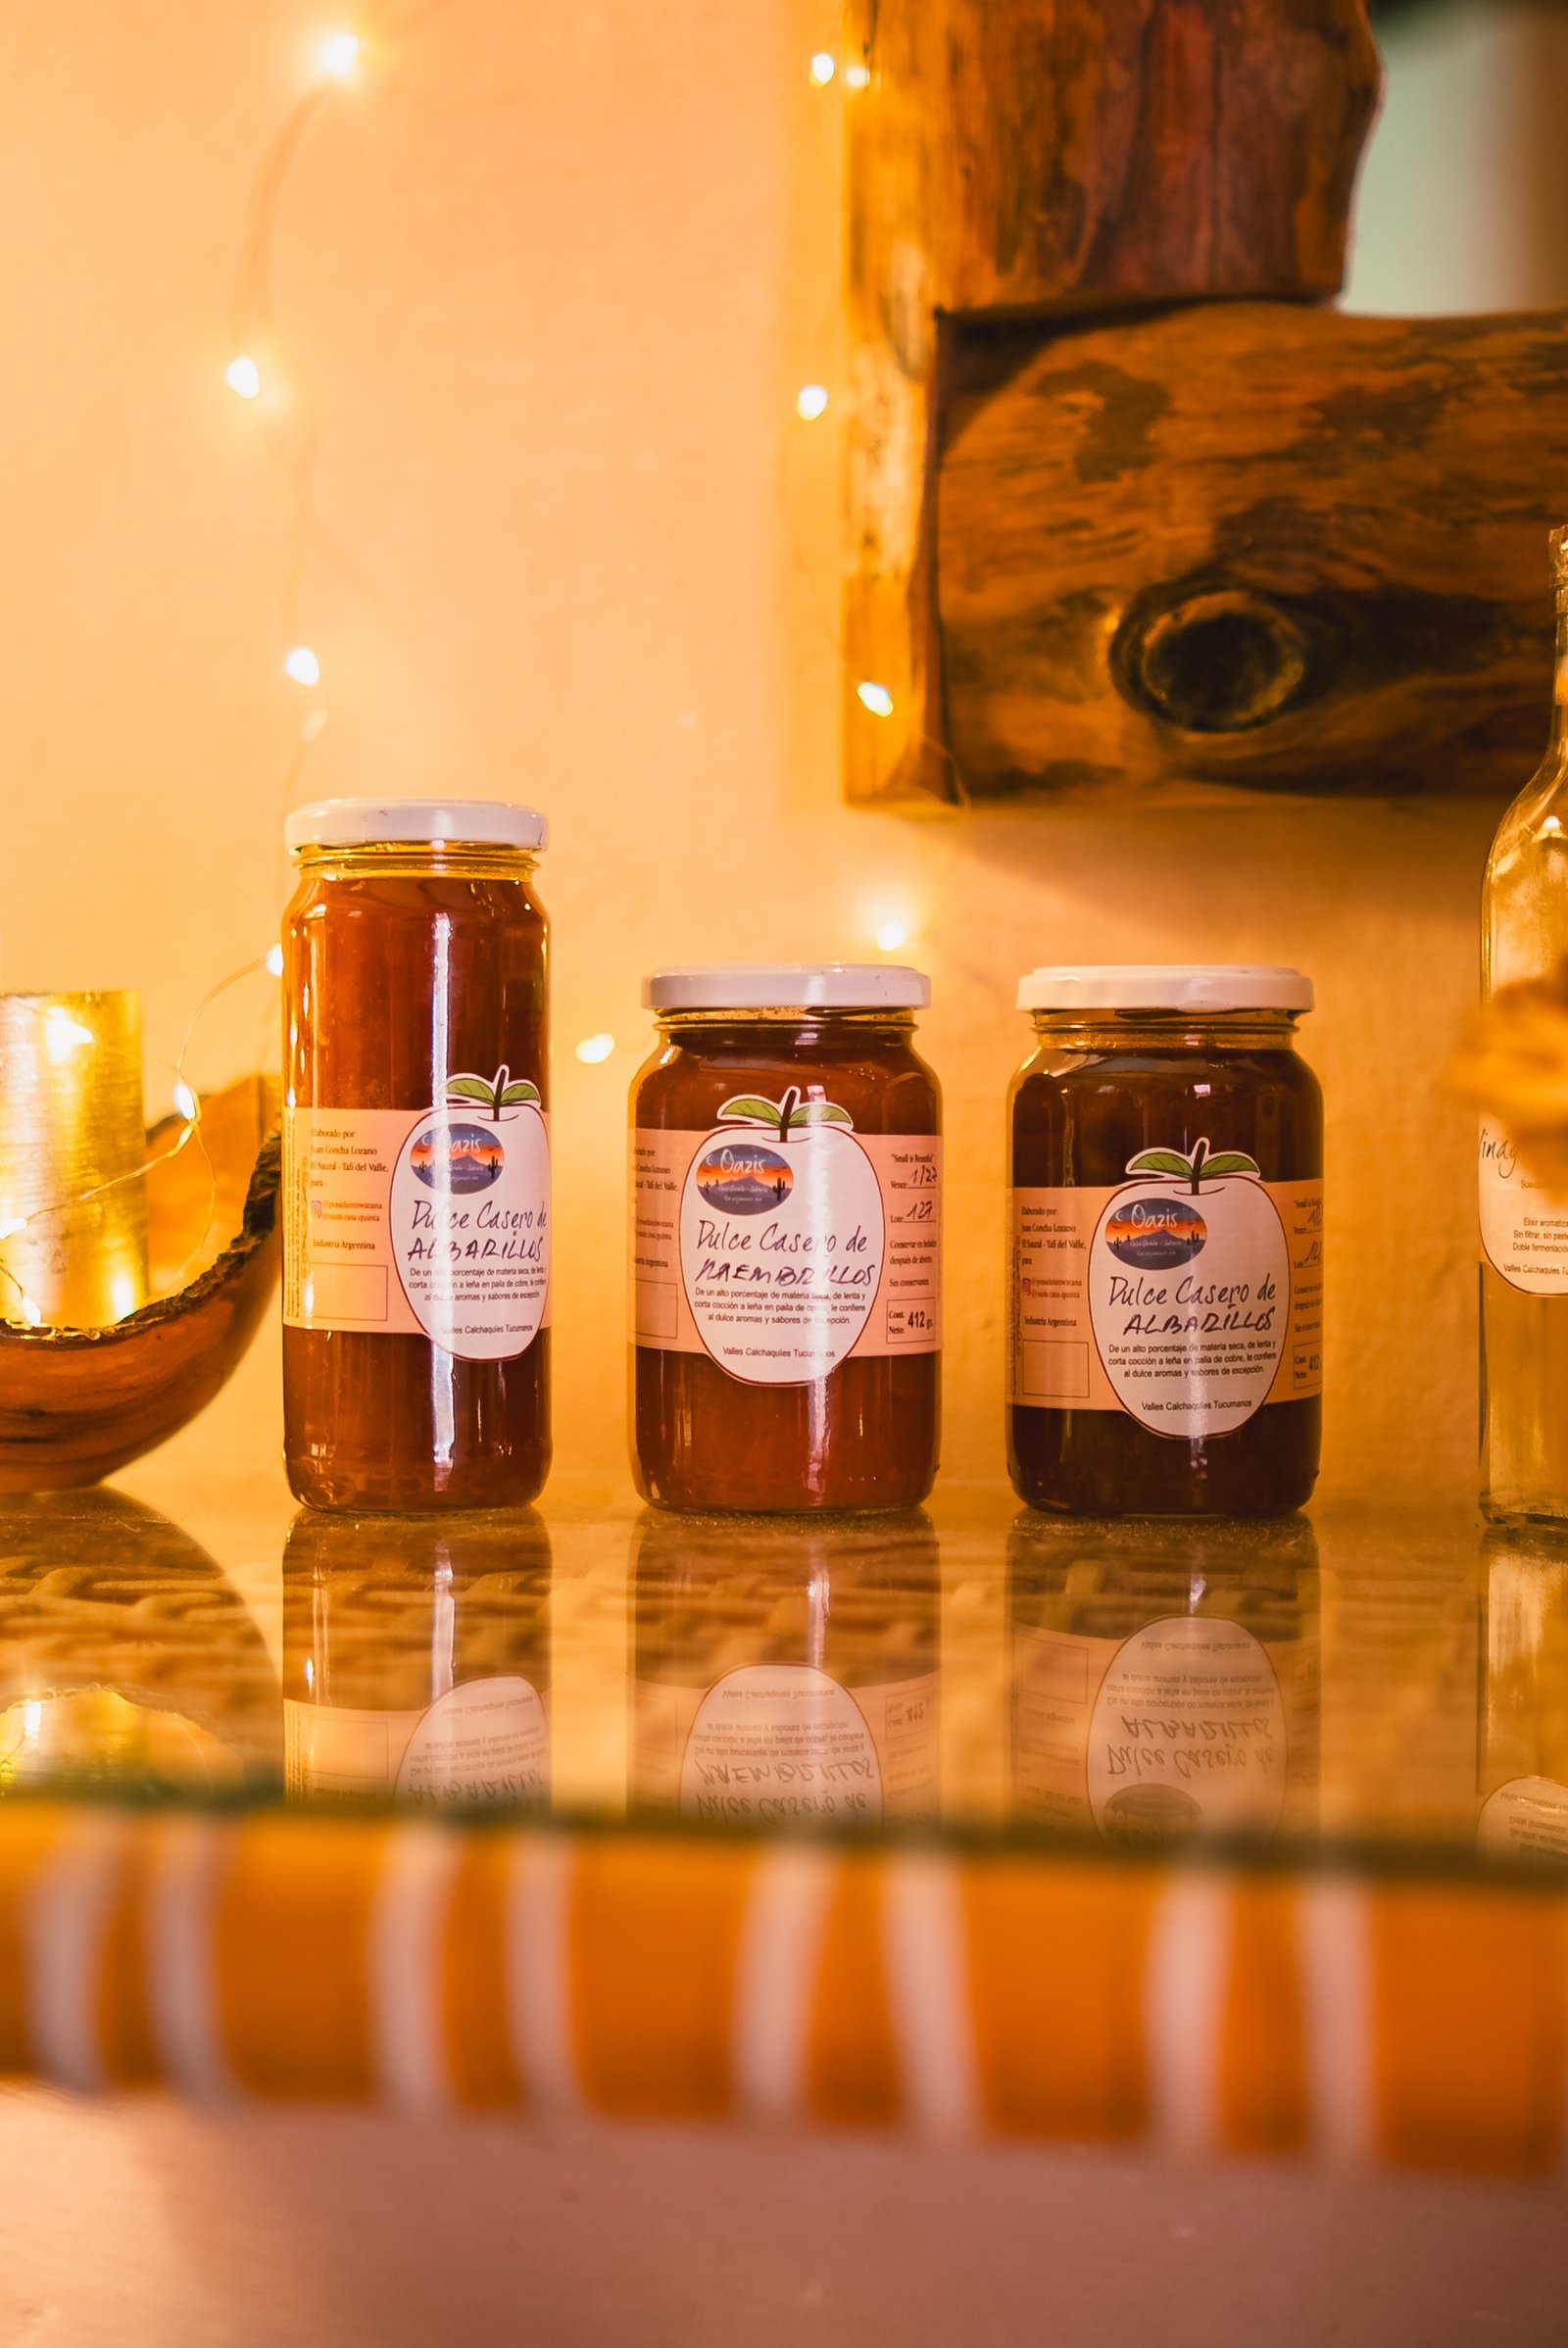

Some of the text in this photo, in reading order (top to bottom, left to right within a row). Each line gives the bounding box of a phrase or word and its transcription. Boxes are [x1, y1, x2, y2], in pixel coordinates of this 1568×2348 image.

[351, 1147, 377, 1155] Lozano
[720, 1149, 765, 1174] Oazis
[355, 1163, 367, 1172] del
[412, 1199, 469, 1230] Duce
[476, 1200, 534, 1230] Casero
[1131, 1203, 1179, 1228] Oazis
[1523, 1217, 1539, 1226] Elixir
[1054, 1223, 1076, 1232] Lozano
[697, 1220, 752, 1249] Dulce
[845, 1225, 867, 1253] de
[1514, 1229, 1523, 1239] Sin
[341, 1240, 375, 1250] Argentina
[1057, 1240, 1067, 1248] del
[1512, 1242, 1530, 1251] Doble
[912, 1255, 919, 1264] de
[1503, 1263, 1521, 1273] Valles
[409, 1280, 427, 1289] corta
[466, 1279, 480, 1288] leña
[889, 1278, 899, 1287] Sin
[695, 1287, 705, 1296] De
[731, 1290, 768, 1300] porcentaje
[833, 1291, 842, 1299] de
[1108, 1273, 1276, 1306] Dulce Casero de
[712, 1300, 738, 1309] cocción
[839, 1303, 865, 1312] confiere
[764, 1316, 769, 1325] y
[907, 1310, 925, 1329] 412
[1048, 1317, 1076, 1328] Argentina
[723, 1346, 743, 1355] Valles
[1148, 1344, 1187, 1354] porcentaje
[1200, 1342, 1227, 1350] materia
[1257, 1340, 1271, 1348] lenta
[1128, 1356, 1156, 1365] cocción
[1213, 1354, 1222, 1363] de
[1142, 1402, 1164, 1411] Valles
[1213, 1399, 1252, 1409] Tucumanos
